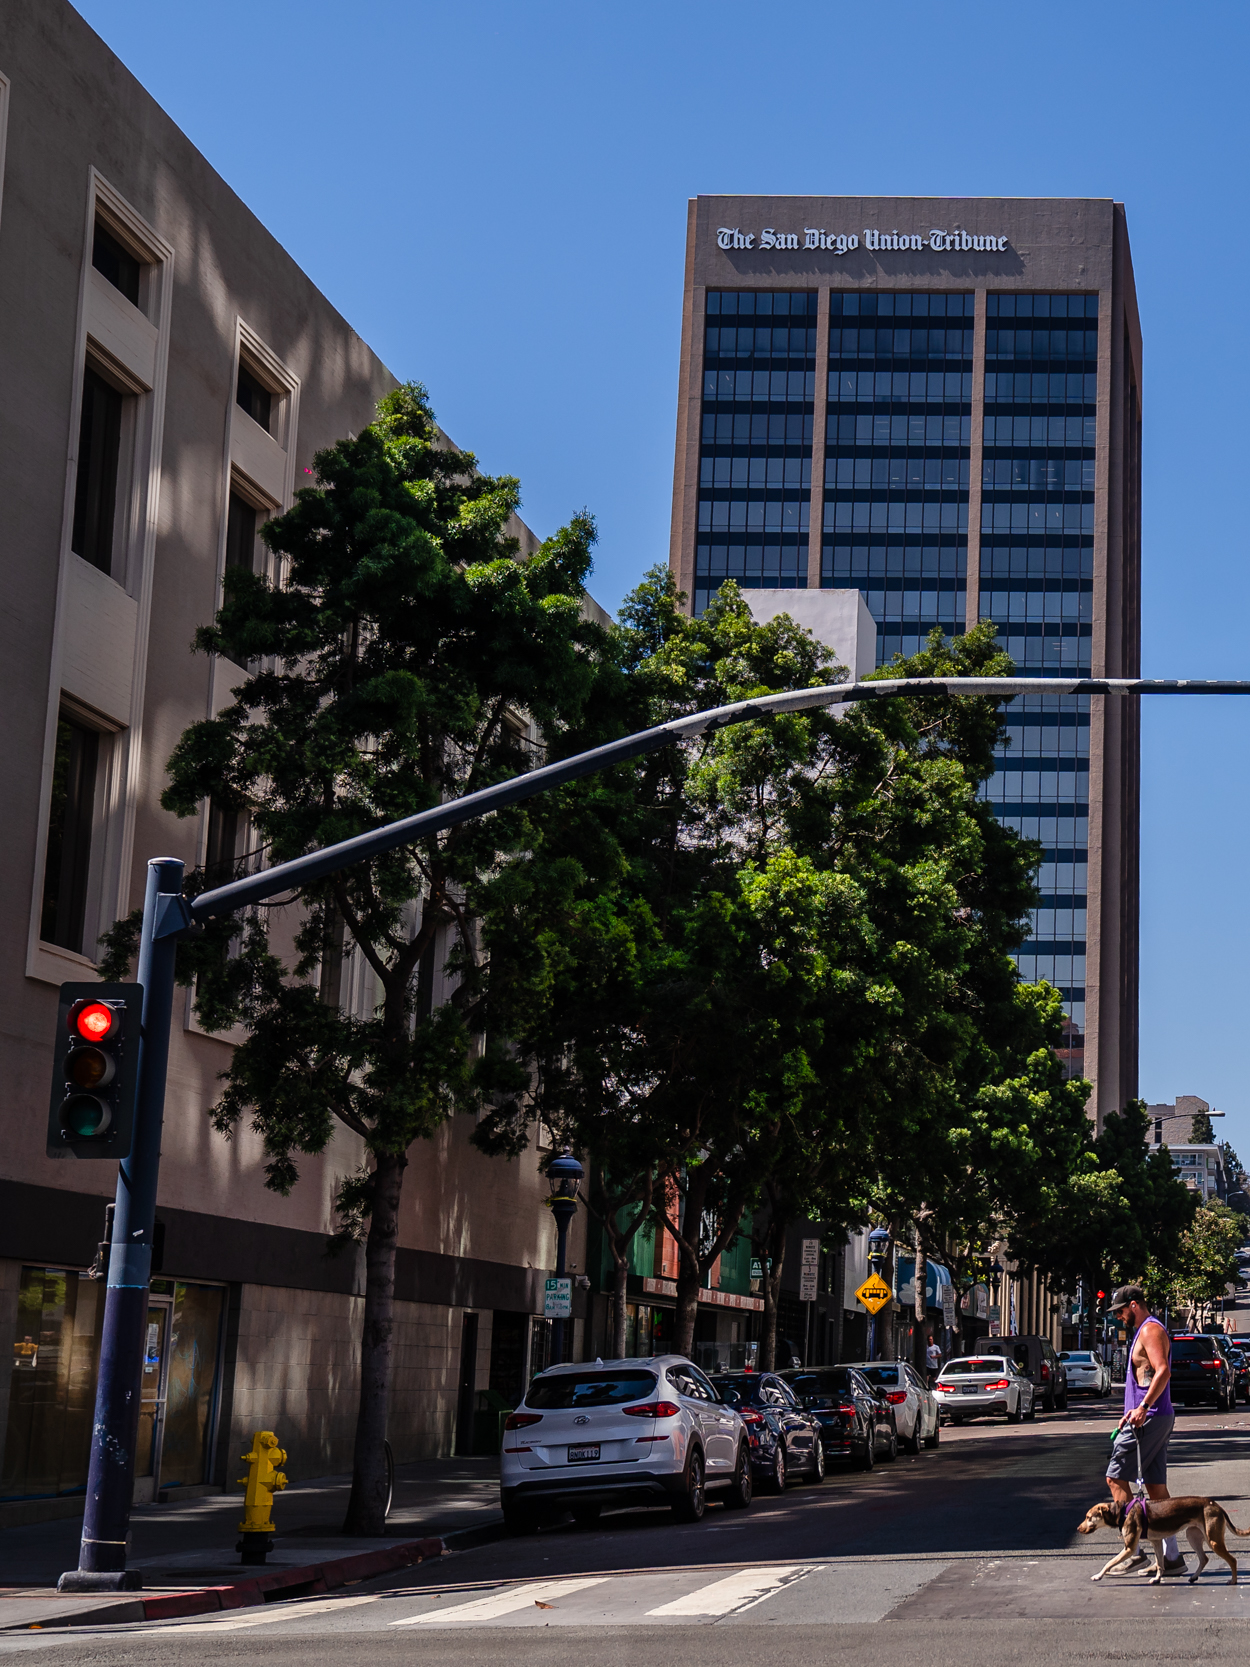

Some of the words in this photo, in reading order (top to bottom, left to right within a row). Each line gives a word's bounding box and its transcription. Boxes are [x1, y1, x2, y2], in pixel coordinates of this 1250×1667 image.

[716, 227, 755, 250] The
[758, 227, 799, 250] San
[802, 226, 859, 255] Diego
[863, 228, 1009, 252] Union-Tribune
[546, 1280, 557, 1290] 15
[546, 1293, 570, 1301] PARKING
